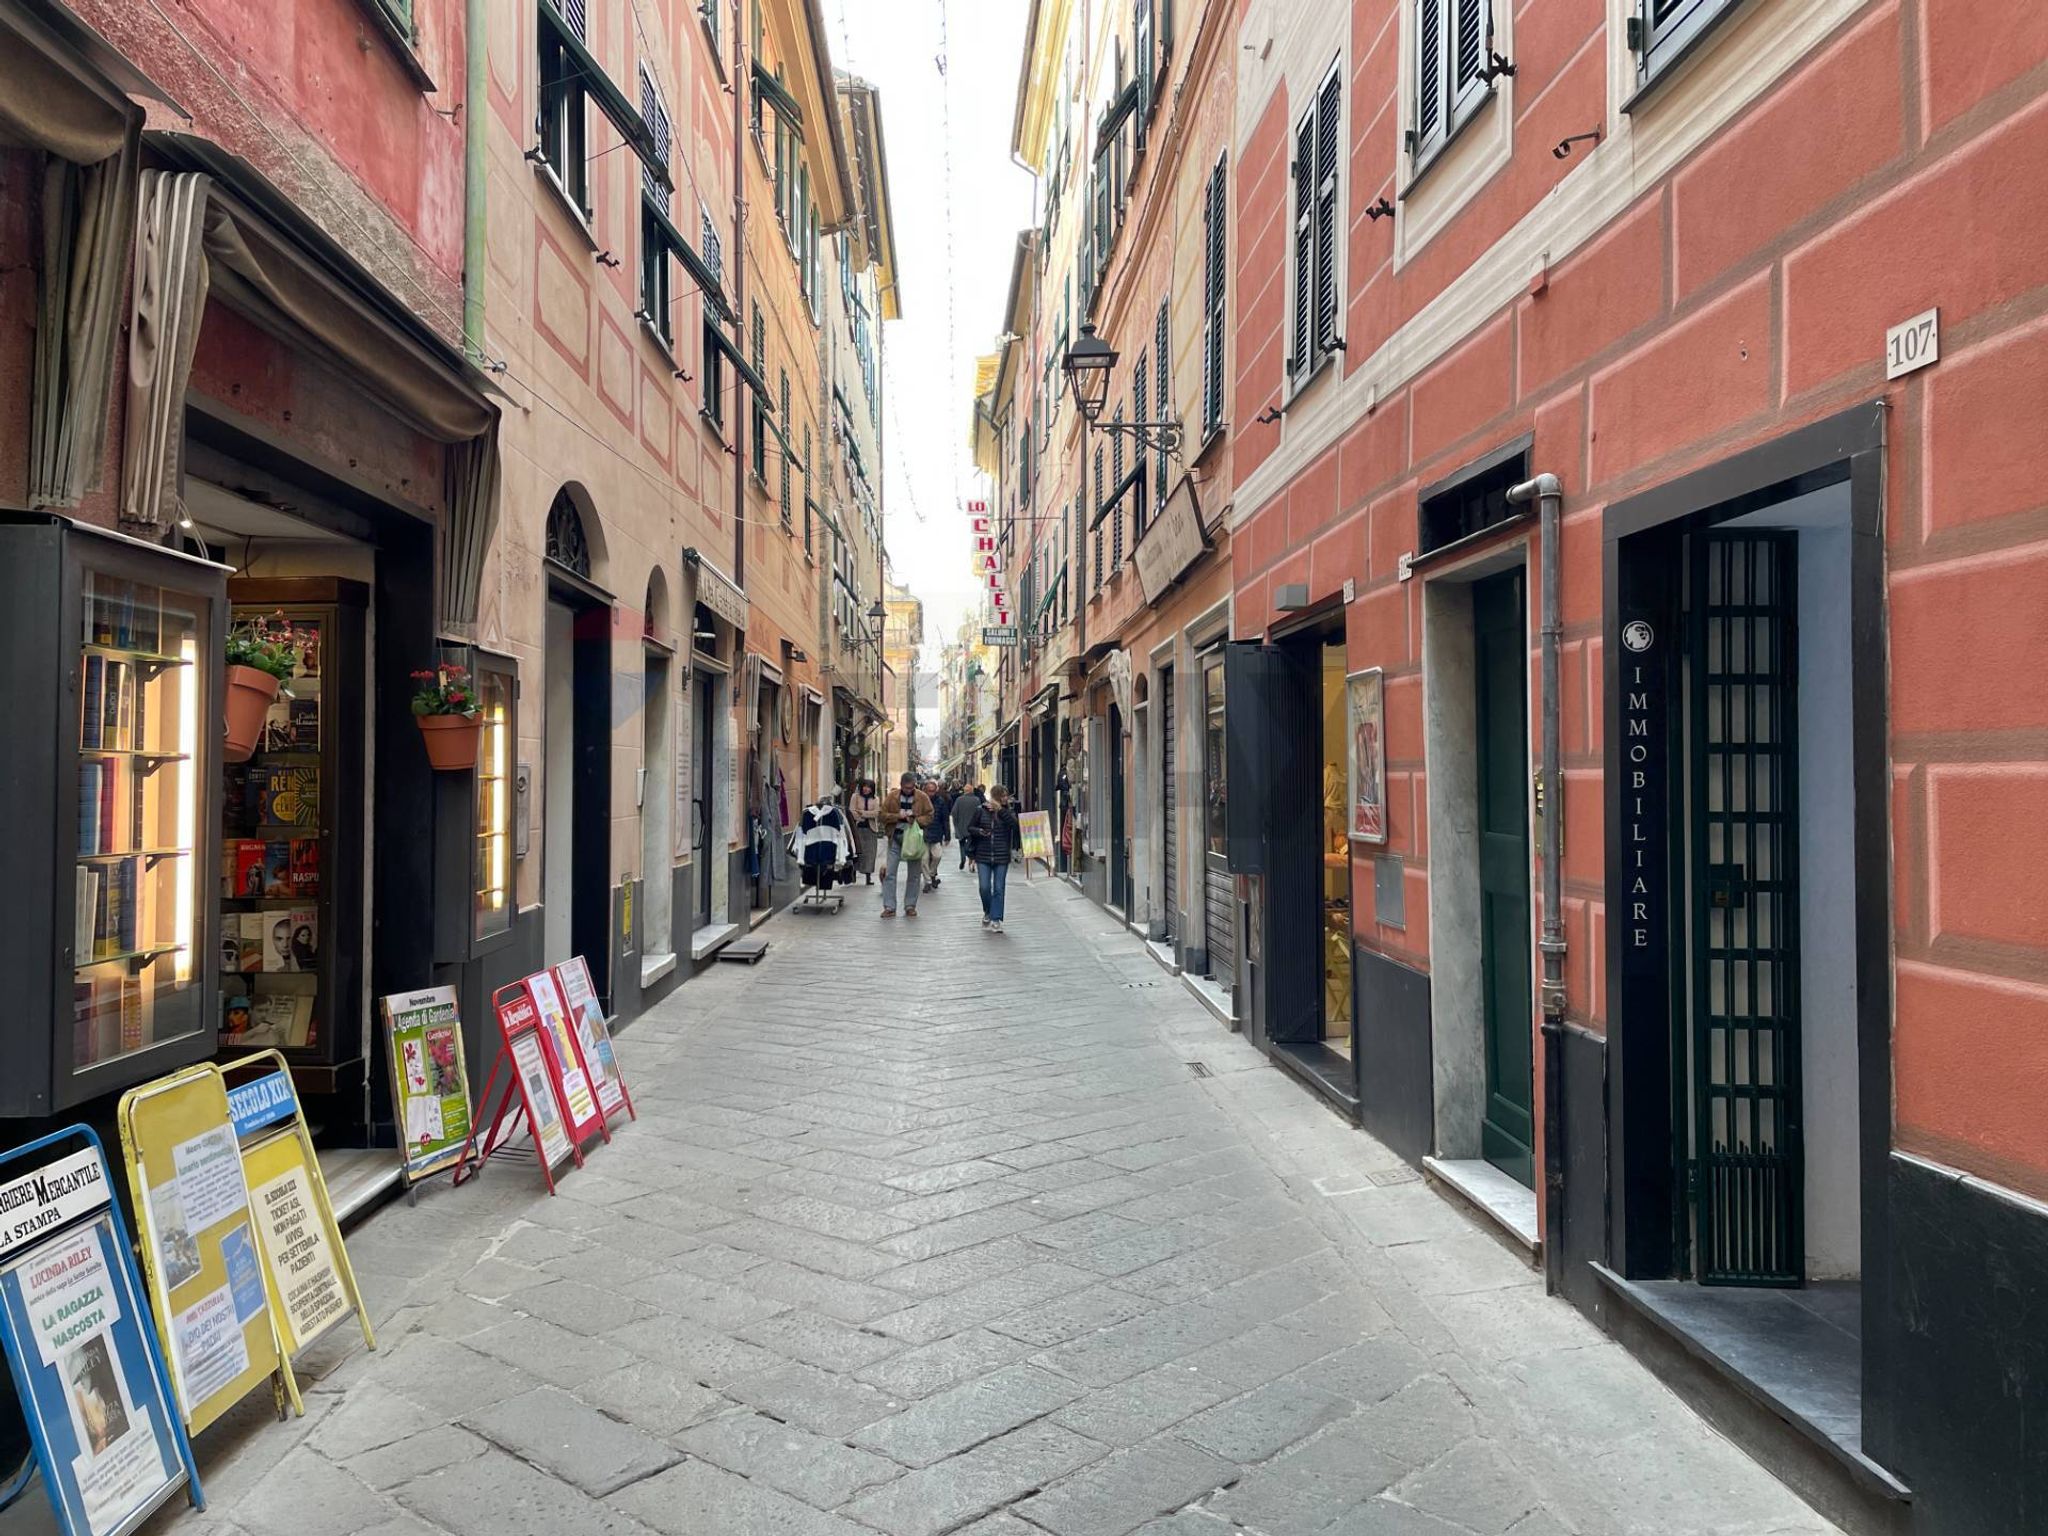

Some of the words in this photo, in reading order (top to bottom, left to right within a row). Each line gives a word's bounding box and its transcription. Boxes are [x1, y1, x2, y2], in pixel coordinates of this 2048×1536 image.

[1891, 319, 1933, 368] 107
[968, 501, 985, 512] LO
[973, 518, 1010, 625] CHALET
[1627, 666, 1649, 947] IMMOBILIARE
[228, 1083, 271, 1122] SECOLO
[267, 1076, 291, 1105] XIX
[31, 1162, 101, 1207] MERCANTILE
[14, 1207, 62, 1240] STAMPA
[30, 1260, 68, 1290] LUCINDA
[66, 1246, 92, 1270] RILEY
[42, 1314, 57, 1331] LA
[56, 1285, 104, 1322] RAGAZZA
[52, 1308, 106, 1349] NASCOSTA
